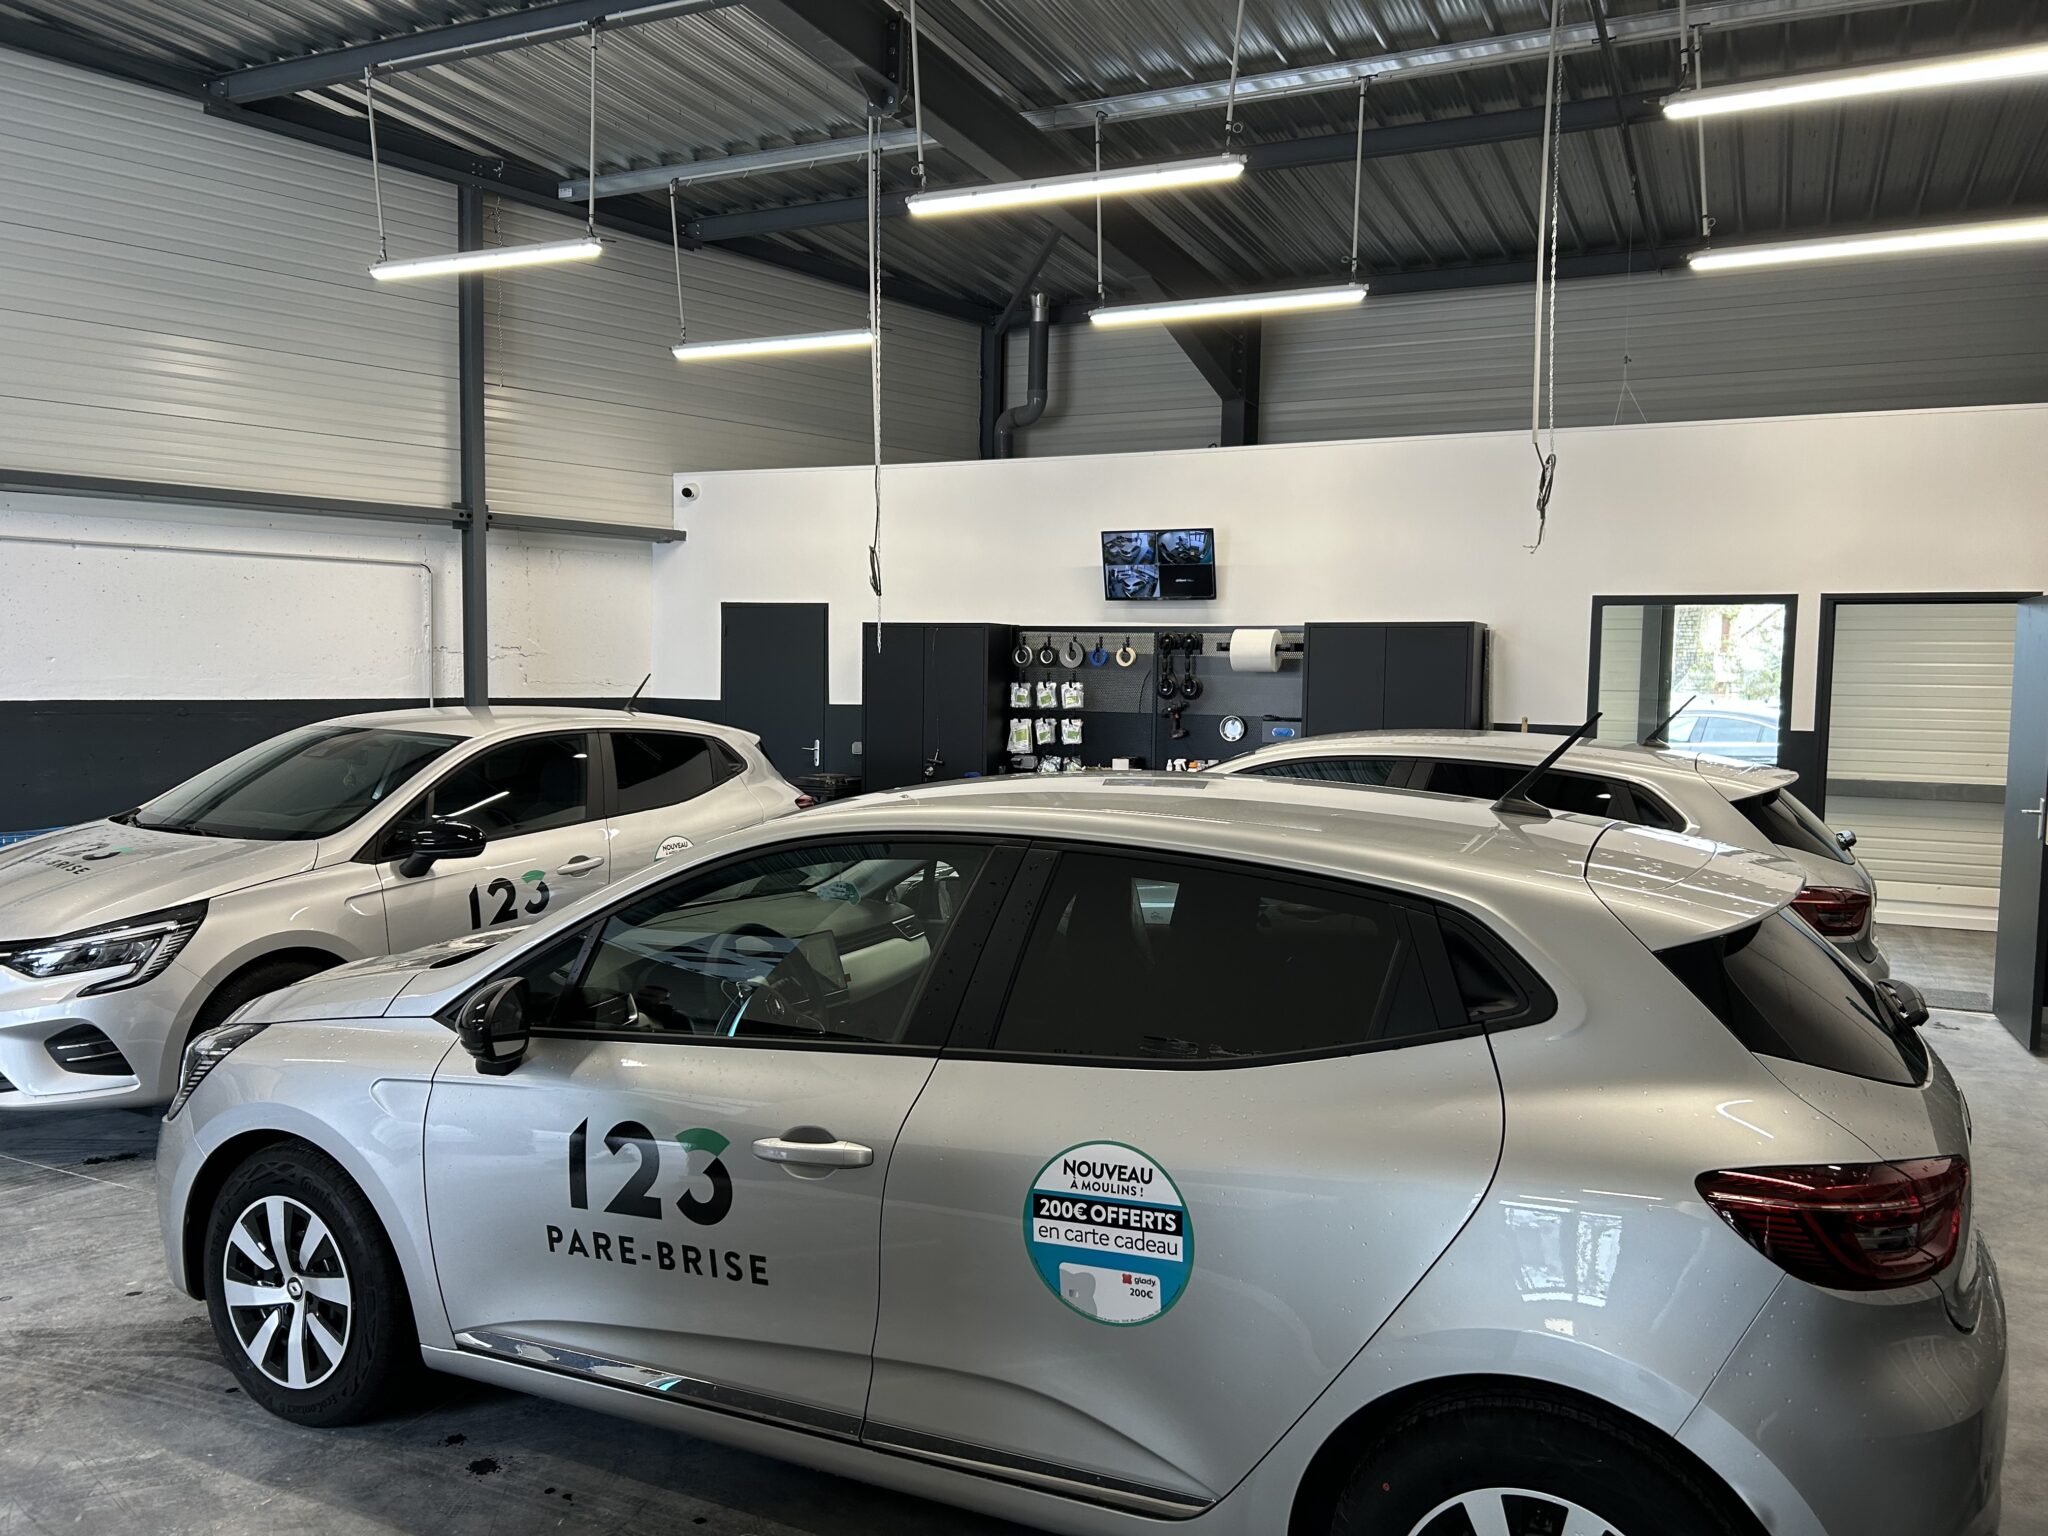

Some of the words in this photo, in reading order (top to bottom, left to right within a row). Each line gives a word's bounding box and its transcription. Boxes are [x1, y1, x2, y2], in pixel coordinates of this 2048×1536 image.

[662, 841, 689, 851] NOUVEAU
[469, 870, 550, 930] 123
[569, 1117, 733, 1226] 123
[1063, 1158, 1154, 1185] NOUVEAU
[1070, 1177, 1079, 1190] À
[1081, 1181, 1138, 1197] MOULINS
[1039, 1198, 1088, 1220] 200€
[1090, 1204, 1177, 1232] OFFERTS
[1038, 1225, 1060, 1240] en
[1064, 1228, 1110, 1246] carte
[1114, 1231, 1178, 1256] cadeau
[546, 1225, 769, 1286] PARE-BRISE
[1129, 1287, 1154, 1299] 200€
[1134, 1276, 1156, 1287] glady
